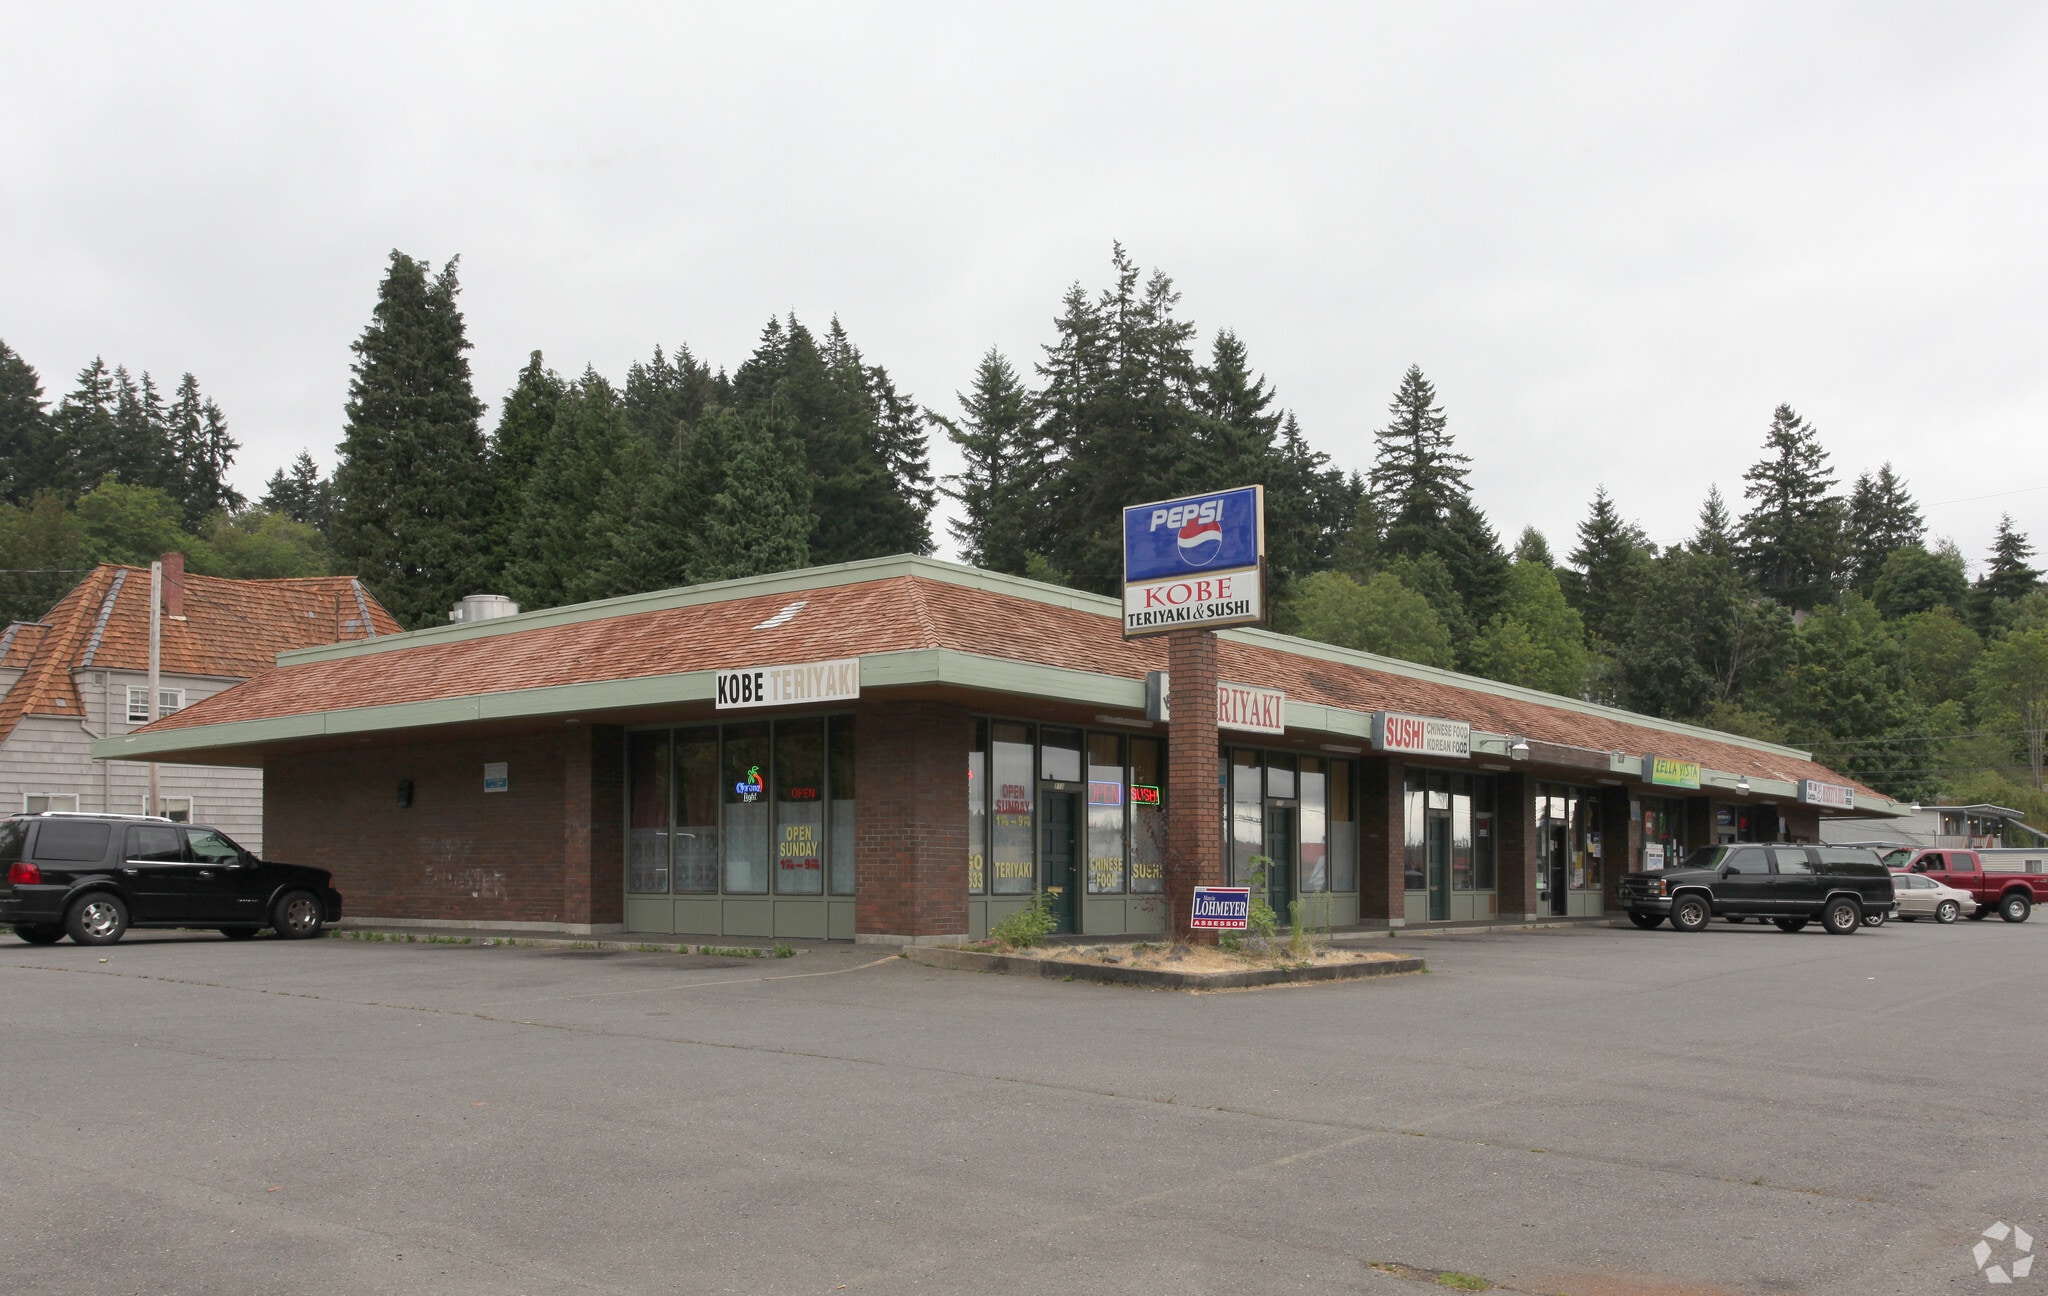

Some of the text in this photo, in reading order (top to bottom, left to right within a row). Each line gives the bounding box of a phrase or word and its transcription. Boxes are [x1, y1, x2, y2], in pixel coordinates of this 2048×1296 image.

[1150, 499, 1224, 532] PEPSI
[1143, 577, 1232, 609] KOBE
[1128, 599, 1250, 627] TERIYAKI & SUSHI
[718, 662, 857, 704] KOBE TERIYAKI
[1219, 687, 1281, 729] RIYAKI
[1386, 717, 1424, 749] SUSHI
[1426, 722, 1468, 739] CHINESE FOOD
[1426, 738, 1467, 753] KOREAN FOOD
[1656, 759, 1698, 778] BELLA VISTA
[791, 787, 816, 798] OPEN
[1002, 784, 1025, 799] OPEN
[1088, 784, 1118, 803] OPEN
[996, 800, 1030, 815] SUNDAY
[786, 826, 812, 841] OPEN
[780, 842, 818, 857] SUNDAY
[994, 862, 1032, 878] TERIYAKI
[1089, 857, 1122, 871] CHINESE
[1096, 873, 1117, 887] FOOD
[1193, 919, 1245, 927] ASSESSOR
